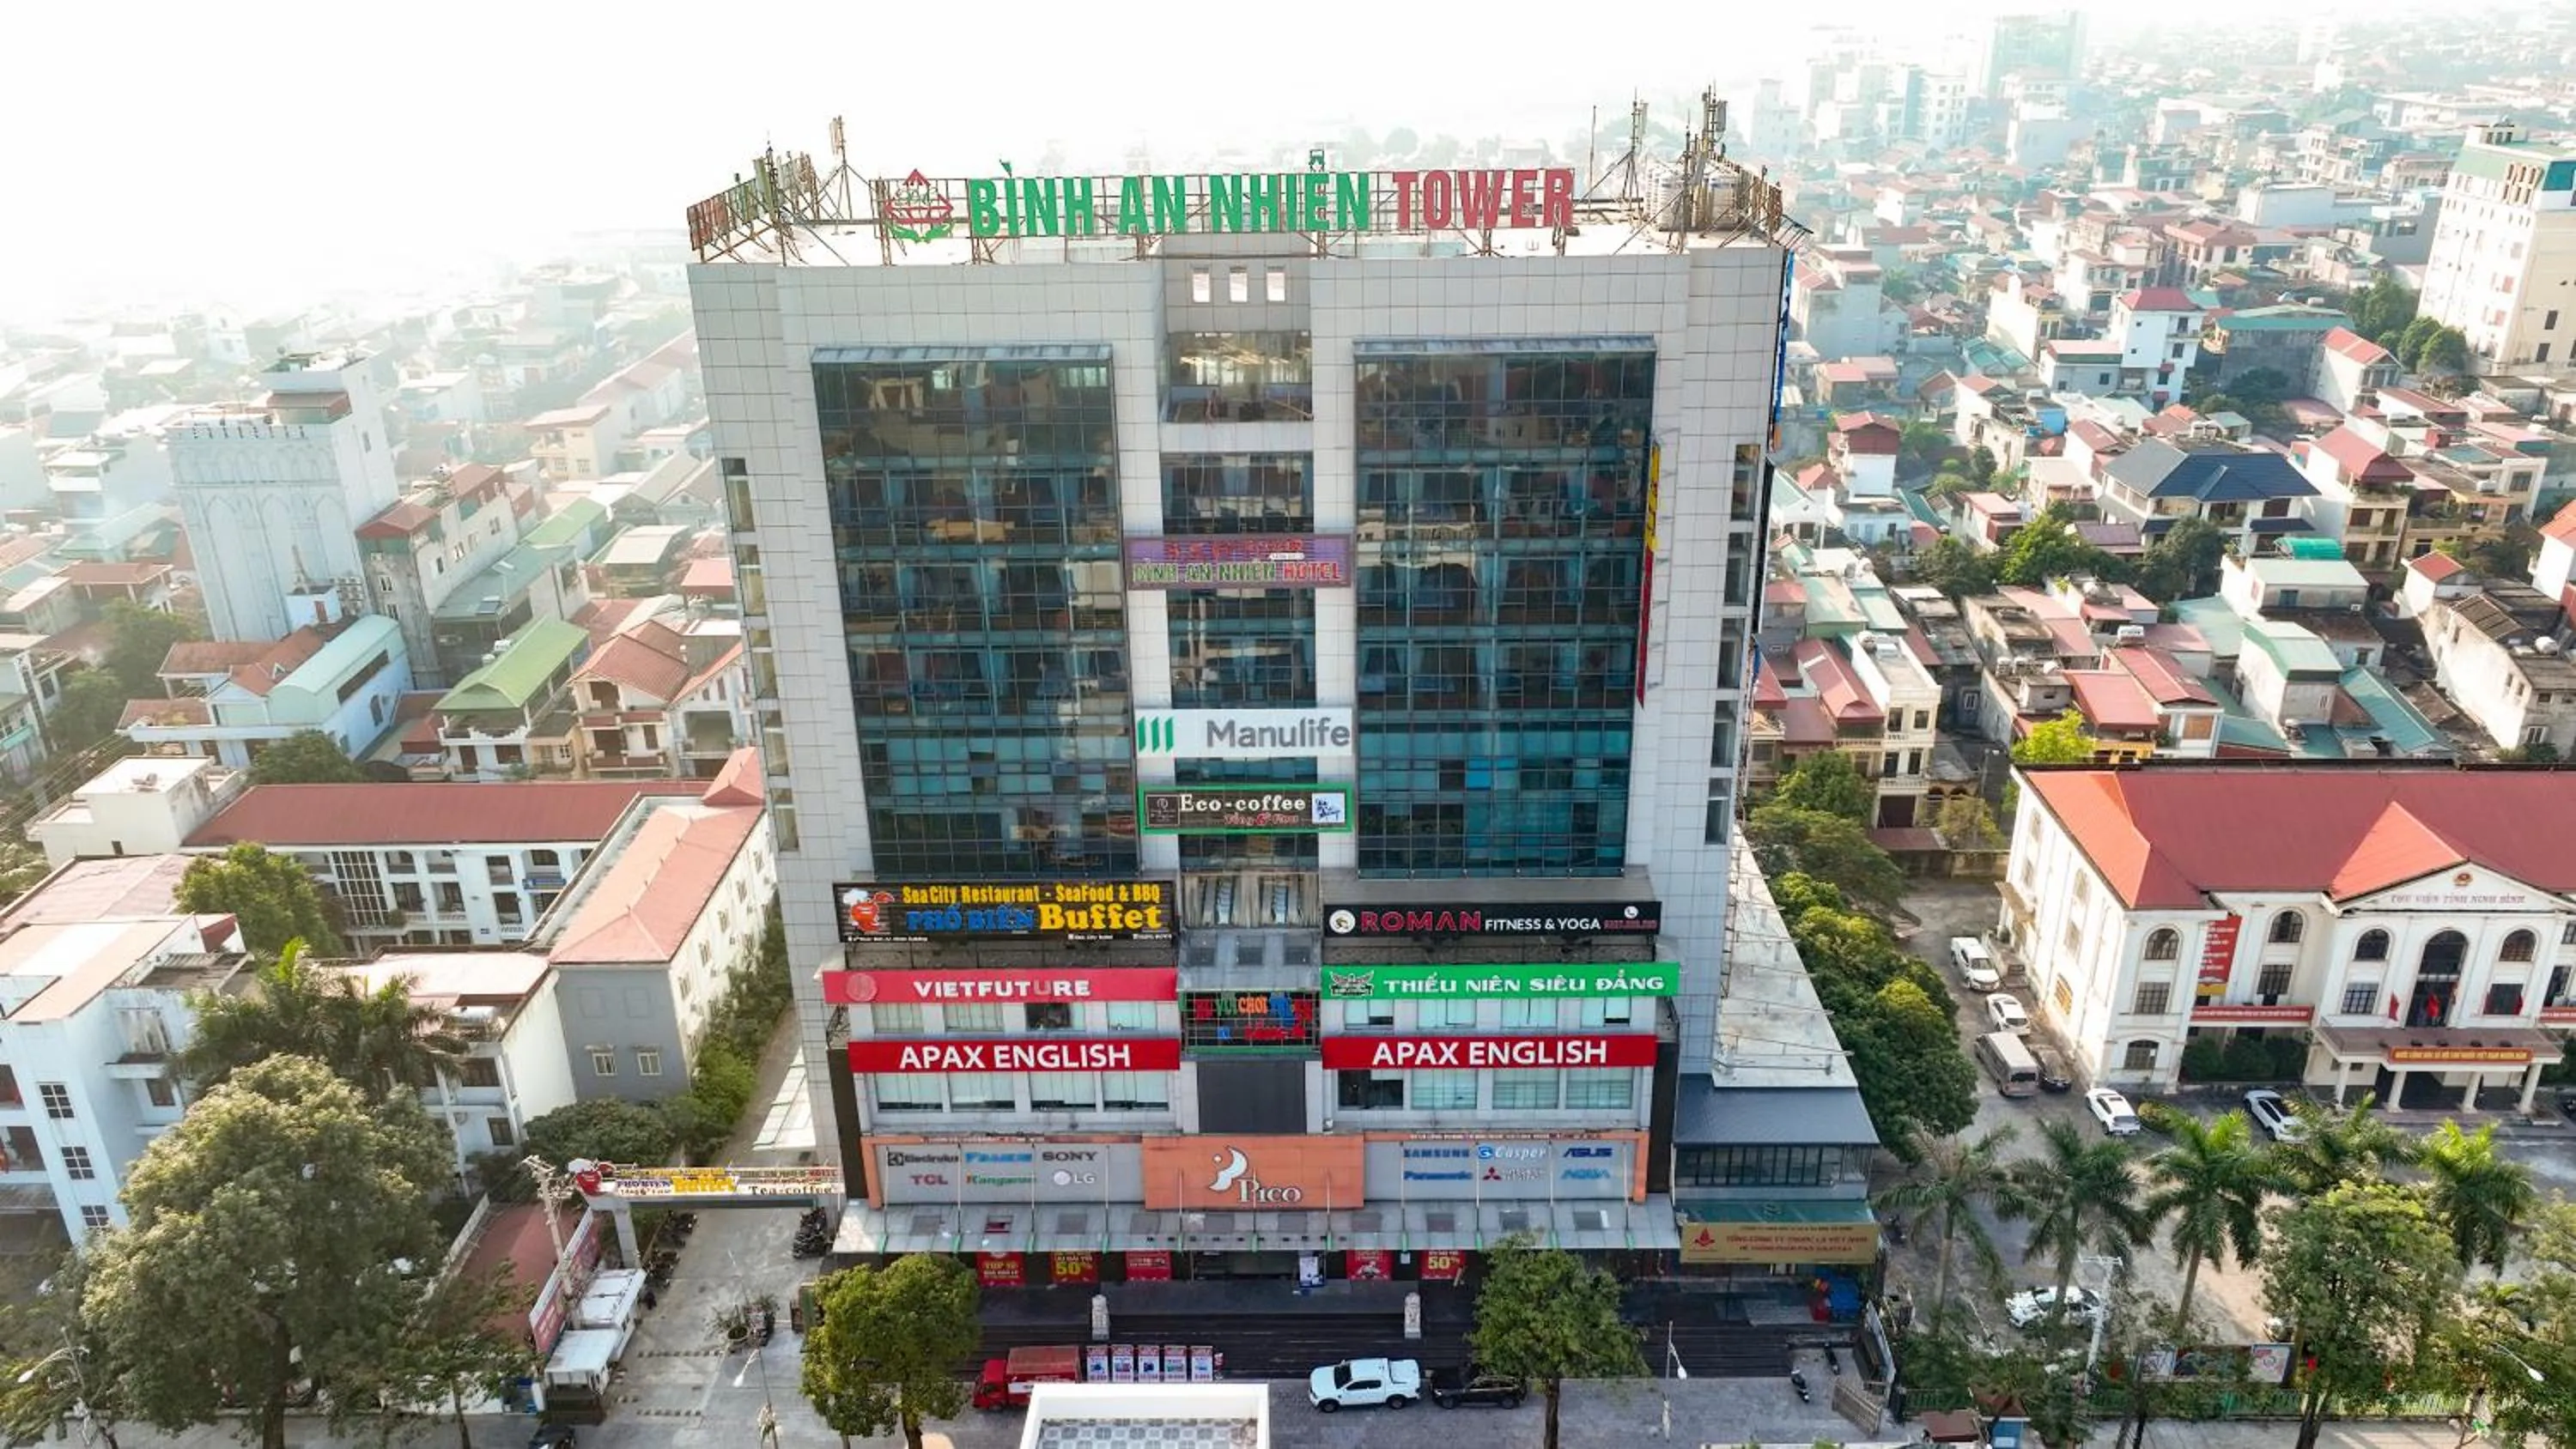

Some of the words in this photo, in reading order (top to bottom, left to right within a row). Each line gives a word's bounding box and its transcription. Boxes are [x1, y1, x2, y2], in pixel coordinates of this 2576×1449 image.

[969, 159, 1092, 237] BÌNH
[1118, 175, 1186, 236] AN
[1209, 155, 1370, 233] NHIÊN
[1392, 169, 1574, 230] TOWER
[1283, 562, 1341, 581] HOTEL
[1206, 716, 1351, 749] Manulife
[1180, 793, 1306, 812] Eco-coffee
[961, 885, 1040, 904] Restaurant
[1133, 884, 1160, 903] BBQ
[1038, 903, 1163, 931] Buffet
[1360, 911, 1482, 932] ROMAN
[1485, 919, 1541, 931] FITNESS
[1545, 918, 1556, 930] &
[1558, 918, 1601, 931] YOGA
[914, 979, 1091, 997] VIETFUTURE
[1383, 972, 1457, 993] THIẾU
[1465, 977, 1521, 992] NIÊN
[1529, 976, 1587, 991] SIÊU
[899, 1045, 981, 1070] APAX
[993, 1044, 1131, 1069] ENGLISH
[1372, 1041, 1459, 1065] APAX
[1468, 1040, 1607, 1065] ENGLISH
[1042, 1151, 1097, 1161] SONY
[1404, 1149, 1470, 1158] SAMSUNG
[1495, 1145, 1546, 1160] Casper
[1563, 1148, 1613, 1158] ASUS
[910, 1174, 949, 1185] TCL
[1073, 1173, 1096, 1184] LG
